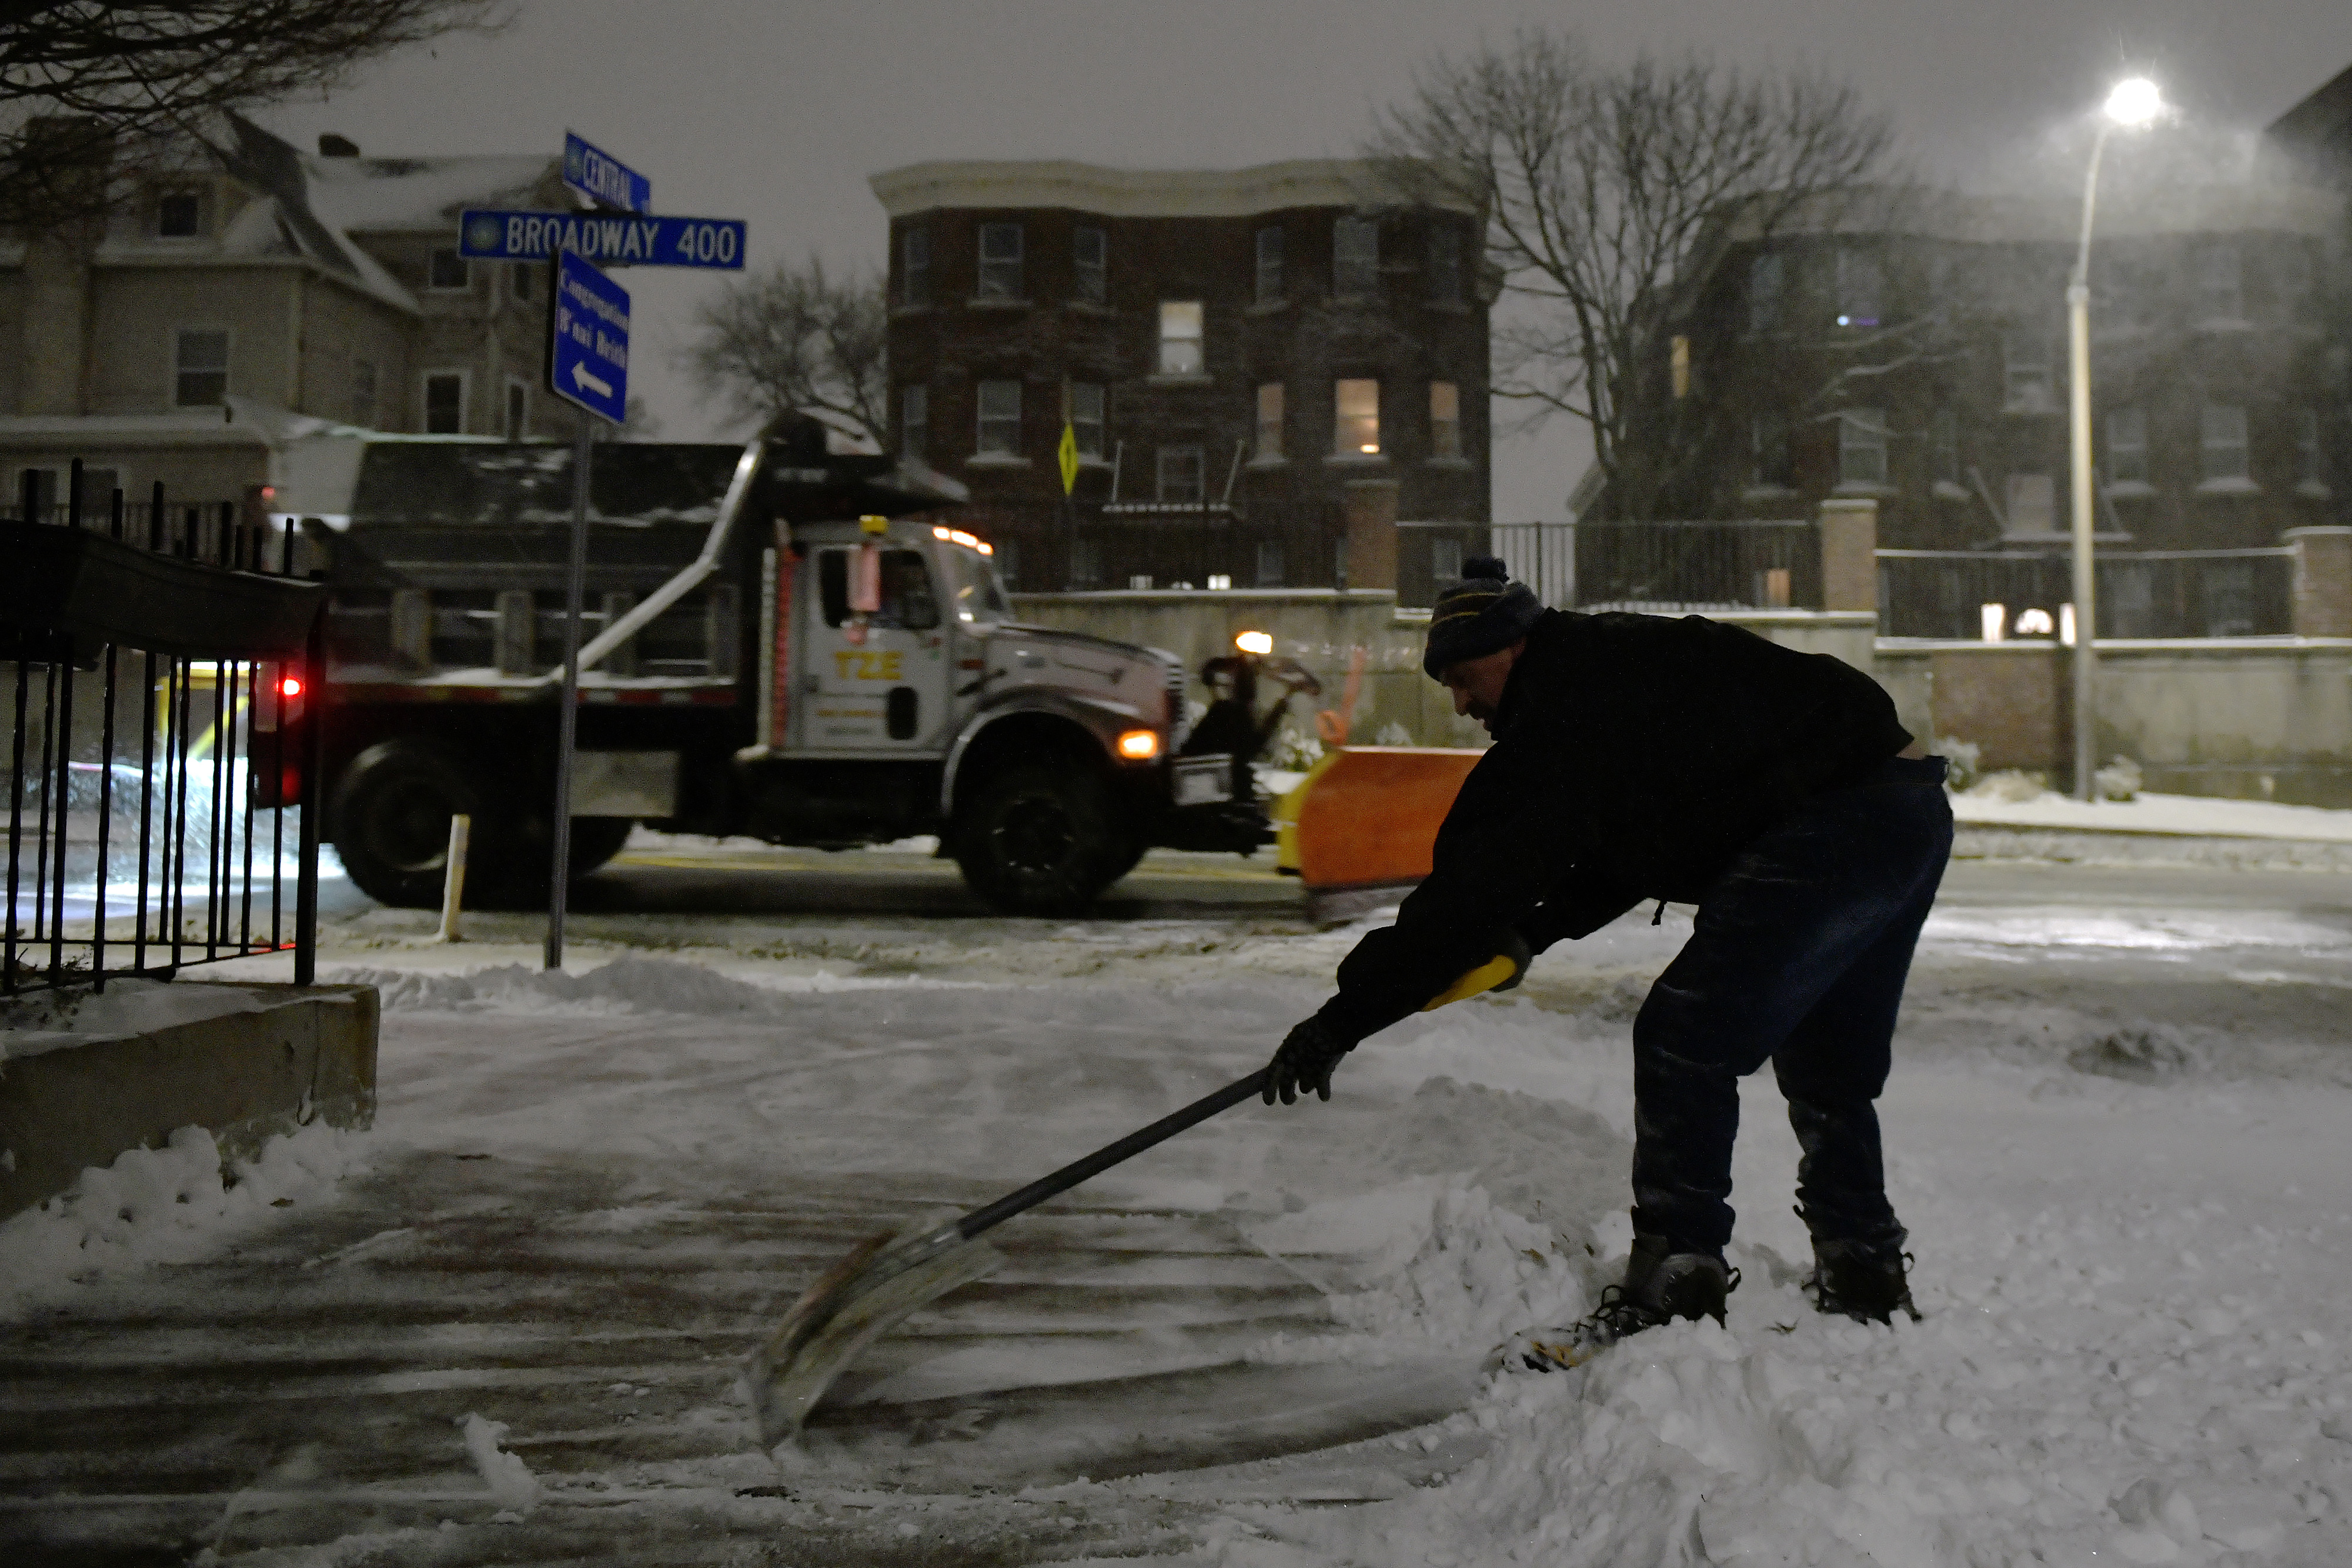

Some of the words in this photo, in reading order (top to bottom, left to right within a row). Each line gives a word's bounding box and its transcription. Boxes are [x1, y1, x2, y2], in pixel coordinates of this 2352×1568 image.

[584, 148, 633, 211] CENTRAL
[507, 216, 659, 259] BROADWAY
[676, 224, 737, 263] 400
